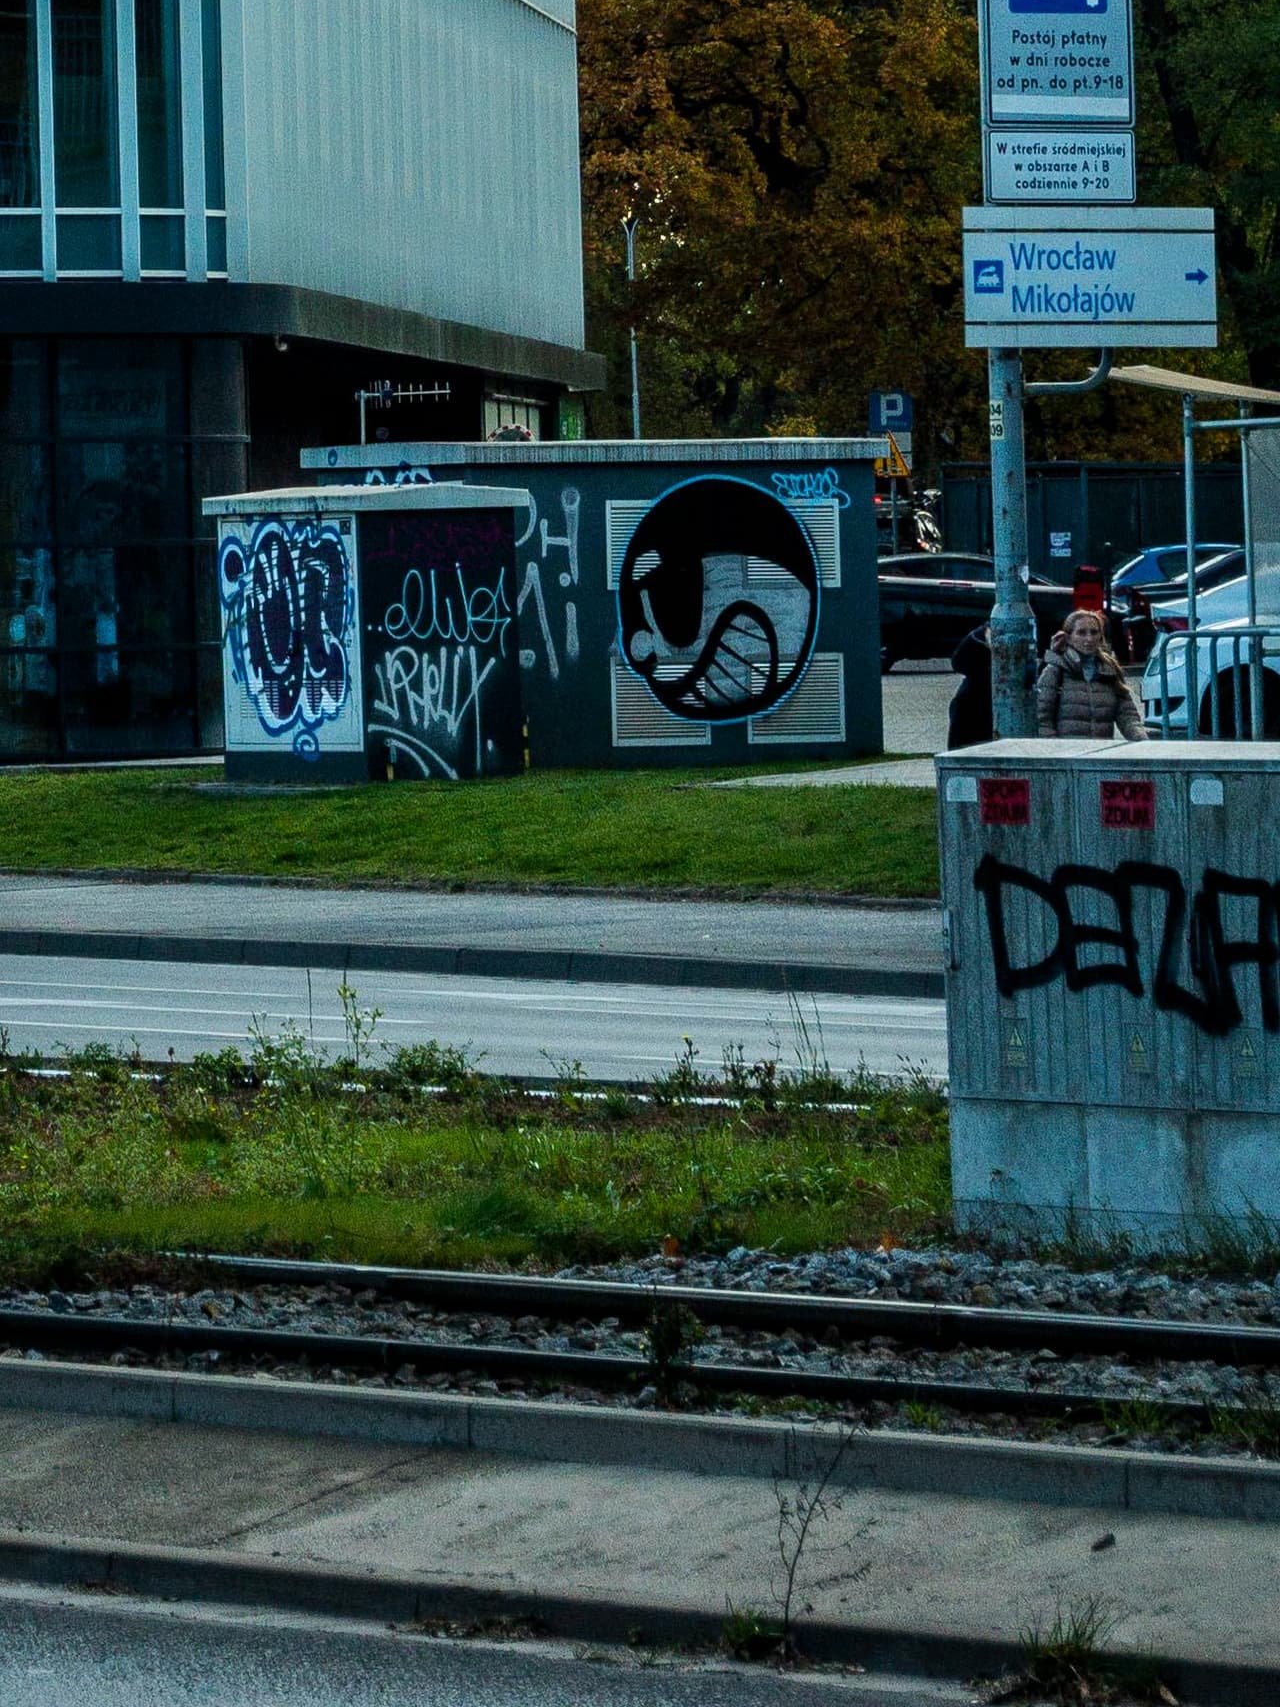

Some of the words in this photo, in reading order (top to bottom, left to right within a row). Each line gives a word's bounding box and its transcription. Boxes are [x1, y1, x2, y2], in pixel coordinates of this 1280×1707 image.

[1012, 29, 1056, 48] Postój
[1061, 29, 1107, 48] płatny
[1009, 55, 1021, 66] w
[1026, 52, 1049, 67] dni
[1054, 52, 1111, 67] robocze
[996, 74, 1015, 88] od
[1021, 77, 1043, 92] pn.
[1049, 74, 1067, 88] do
[996, 142, 1008, 155] W
[1011, 142, 1048, 155] strefie
[1052, 142, 1126, 158] śródmiejskiej
[1014, 162, 1023, 172] w
[1027, 160, 1078, 172] obszarze
[1081, 160, 1090, 172] A
[1102, 160, 1110, 172] B
[1015, 177, 1078, 189] codziennie
[1081, 177, 1110, 189] 9-20
[1009, 241, 1117, 271] Wrocław
[1011, 283, 1136, 320] Mikołajów
[880, 393, 904, 426] P
